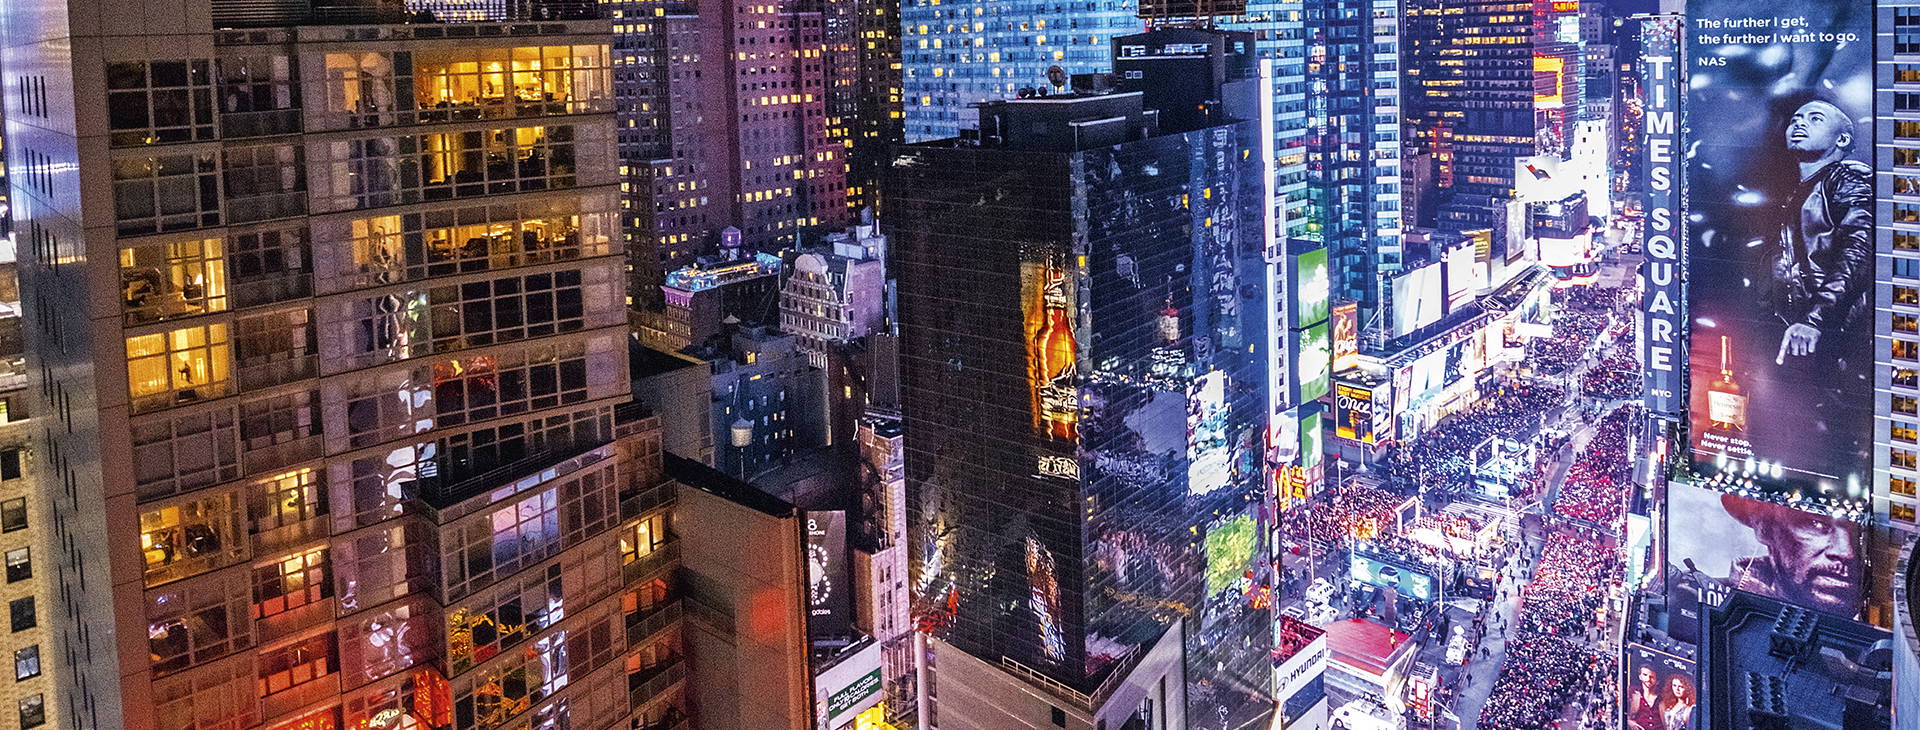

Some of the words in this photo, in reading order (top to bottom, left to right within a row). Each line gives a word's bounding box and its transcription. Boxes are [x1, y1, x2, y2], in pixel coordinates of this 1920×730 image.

[1696, 18, 1721, 29] The
[1723, 17, 1771, 28] further
[1774, 17, 1778, 27] I
[1781, 16, 1809, 29] get,
[1698, 34, 1721, 44] the
[1723, 33, 1770, 44] further
[1773, 33, 1777, 43] I
[1780, 32, 1816, 43] want
[1819, 32, 1834, 42] to
[1836, 33, 1860, 44] go.
[1698, 57, 1727, 67] NAS
[1646, 56, 1674, 191] TIMES
[1647, 207, 1676, 371] SQUARE
[1651, 388, 1673, 398] NYC
[1701, 440, 1726, 450] Never
[1703, 432, 1729, 443] Never
[1730, 438, 1752, 448] stop.
[1291, 648, 1325, 682] HYUNDAI
